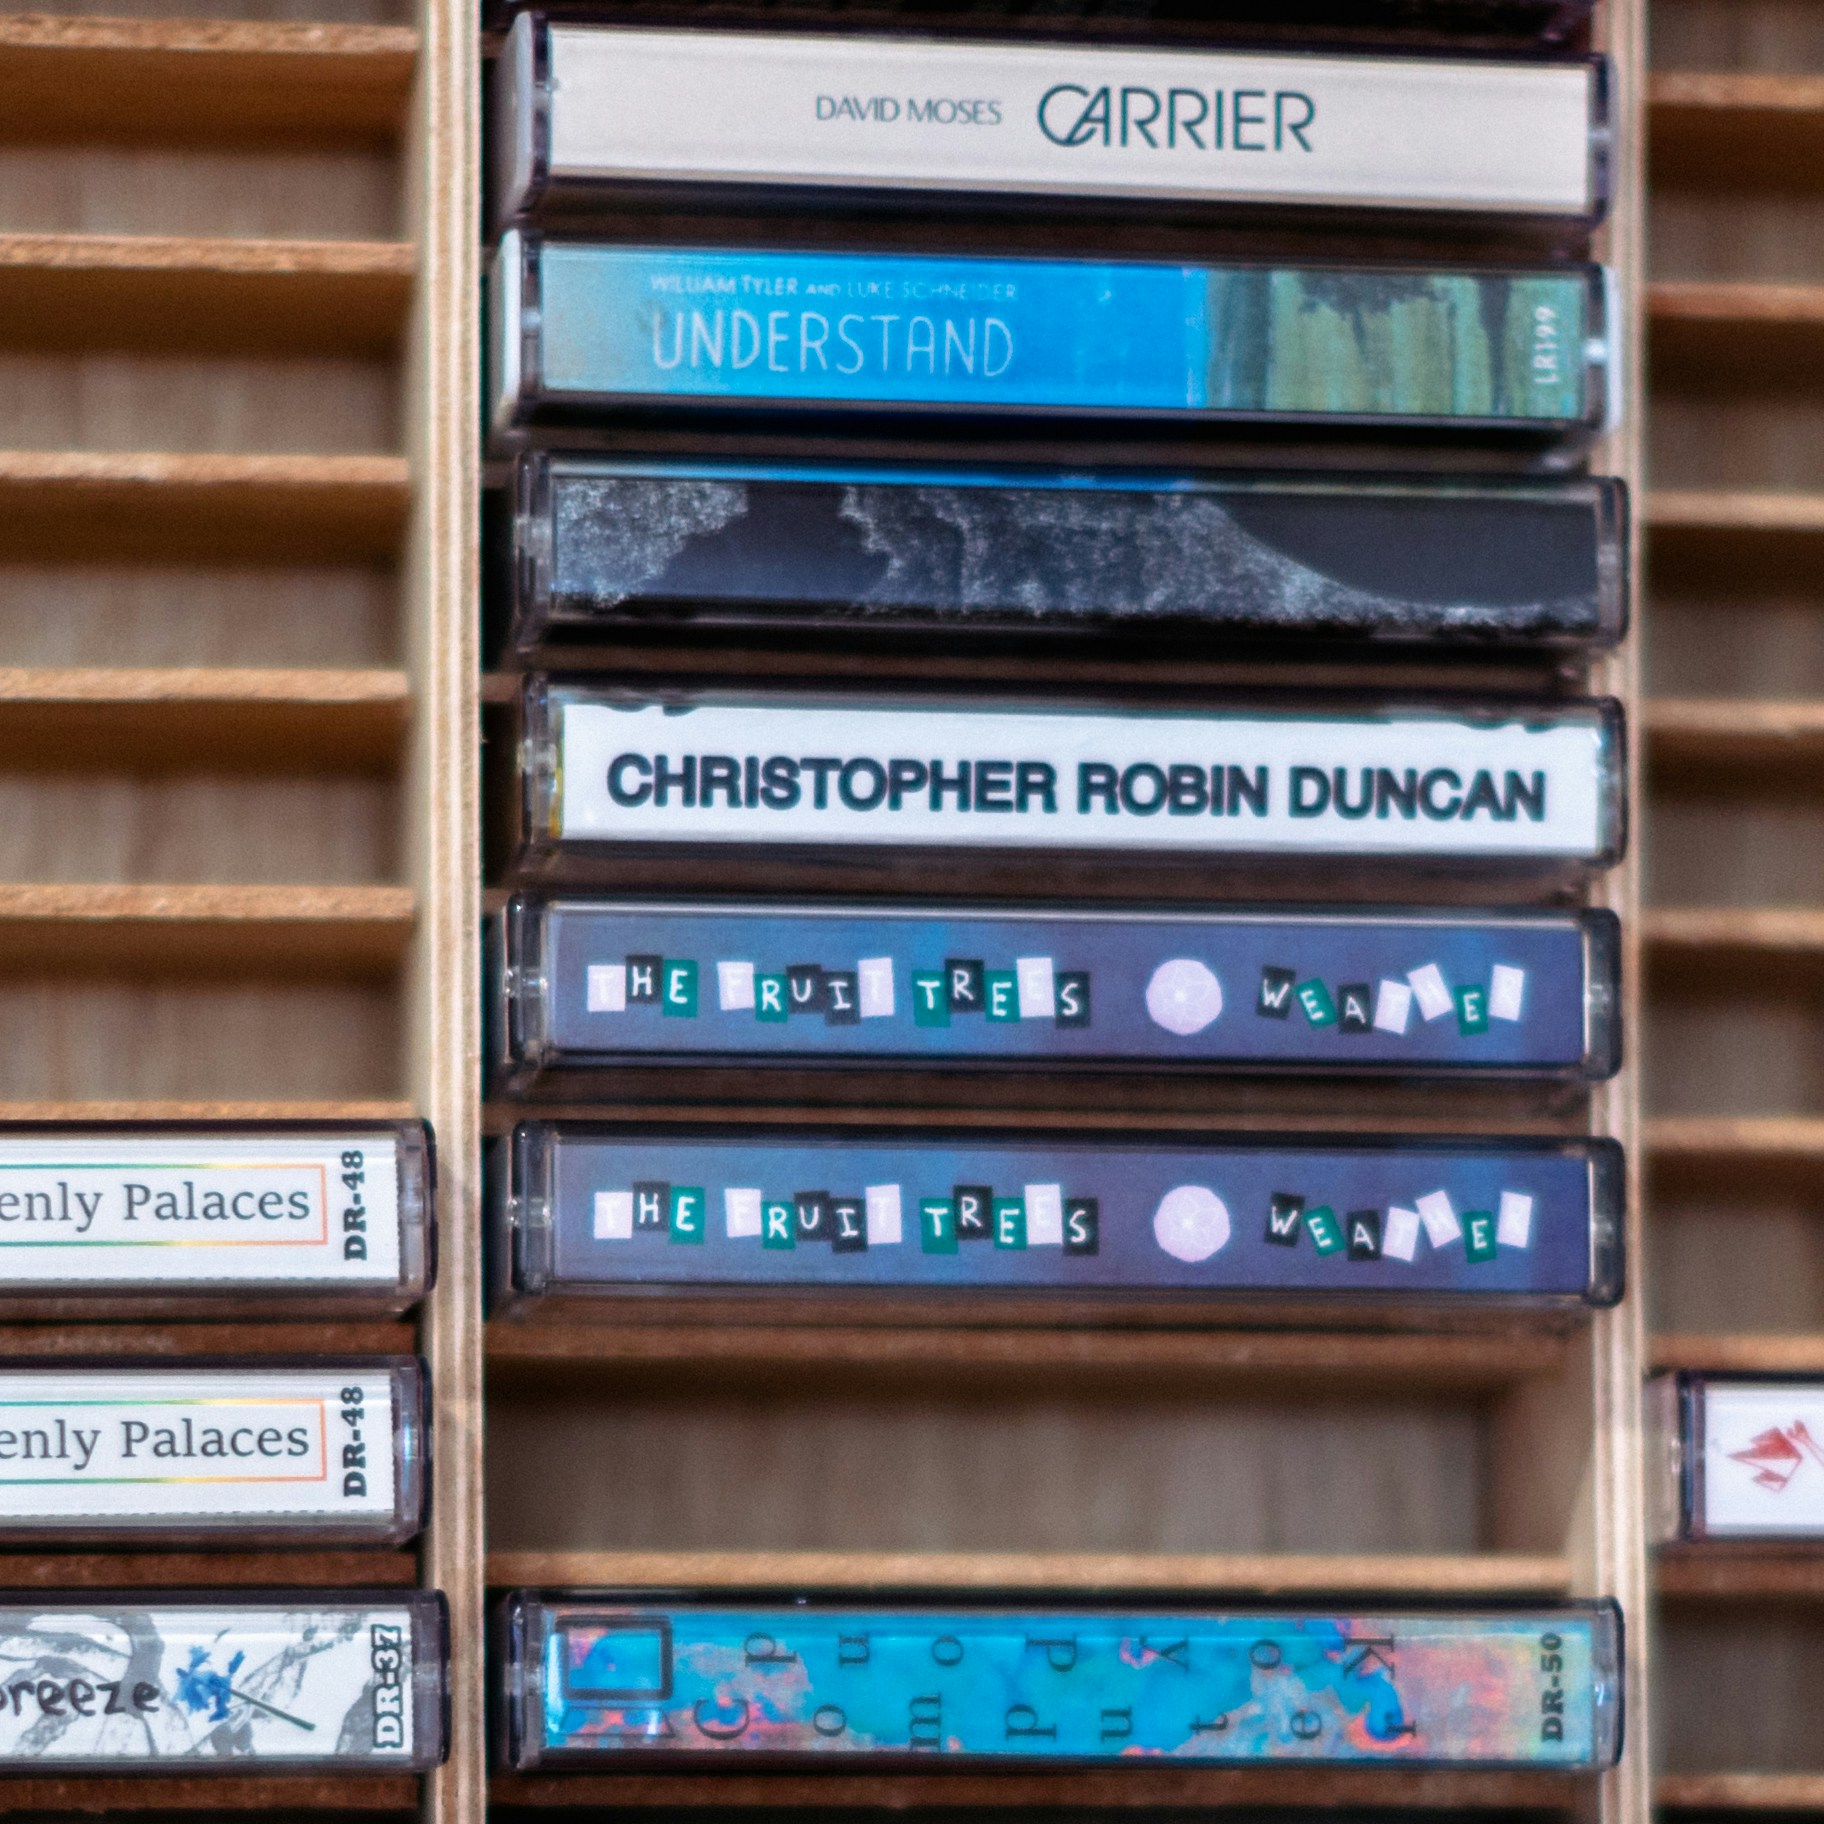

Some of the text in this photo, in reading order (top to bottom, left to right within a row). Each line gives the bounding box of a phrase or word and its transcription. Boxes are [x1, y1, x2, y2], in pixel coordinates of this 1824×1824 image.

[815, 82, 1316, 153] DAVID MOSES CARRIER
[651, 275, 737, 296] WILLIAM
[741, 275, 799, 297] TYLER
[805, 282, 841, 297] AND
[847, 281, 892, 299] LUKE
[651, 310, 1014, 377] UNDERSTAND
[1532, 305, 1559, 387] LR199
[605, 753, 1546, 823] CHRISTOPHER ROBIN DUNCAN
[916, 963, 1082, 1018] TREES
[122, 1181, 311, 1222] Palaces
[340, 1149, 368, 1261] DR-48
[923, 1191, 1090, 1245] TREES
[119, 1418, 311, 1459] Palaces
[340, 1385, 367, 1498] DR-48
[370, 1623, 405, 1749] DR-37
[1540, 1632, 1565, 1744] DR-50
